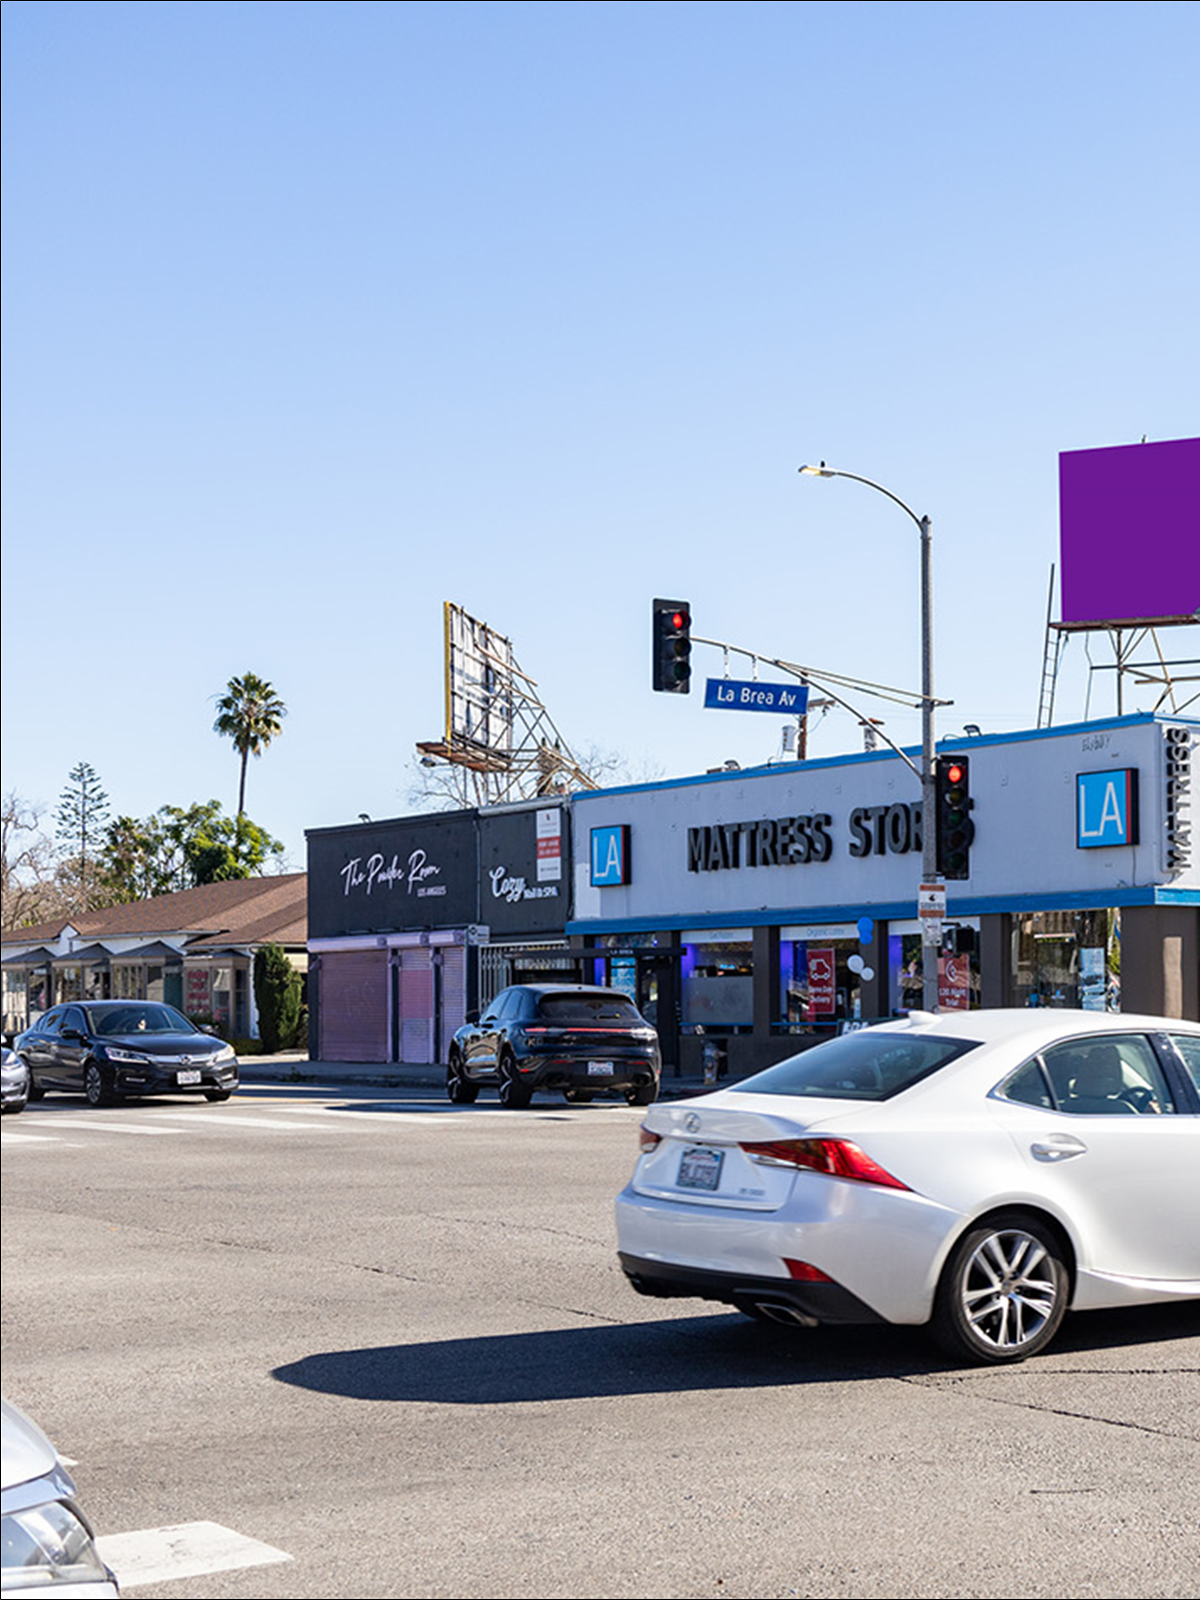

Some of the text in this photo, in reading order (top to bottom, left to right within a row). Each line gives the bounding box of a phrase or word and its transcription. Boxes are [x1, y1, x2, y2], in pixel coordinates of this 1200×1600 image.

[716, 686, 797, 706] La Brea Av
[1081, 782, 1123, 837] LA
[1167, 728, 1192, 868] MATTRESS
[687, 813, 832, 873] MATTRESS
[849, 801, 923, 857] STOR
[340, 857, 366, 896] The
[407, 849, 441, 894] Room
[594, 834, 621, 878] LA
[489, 865, 526, 903] Cozy
